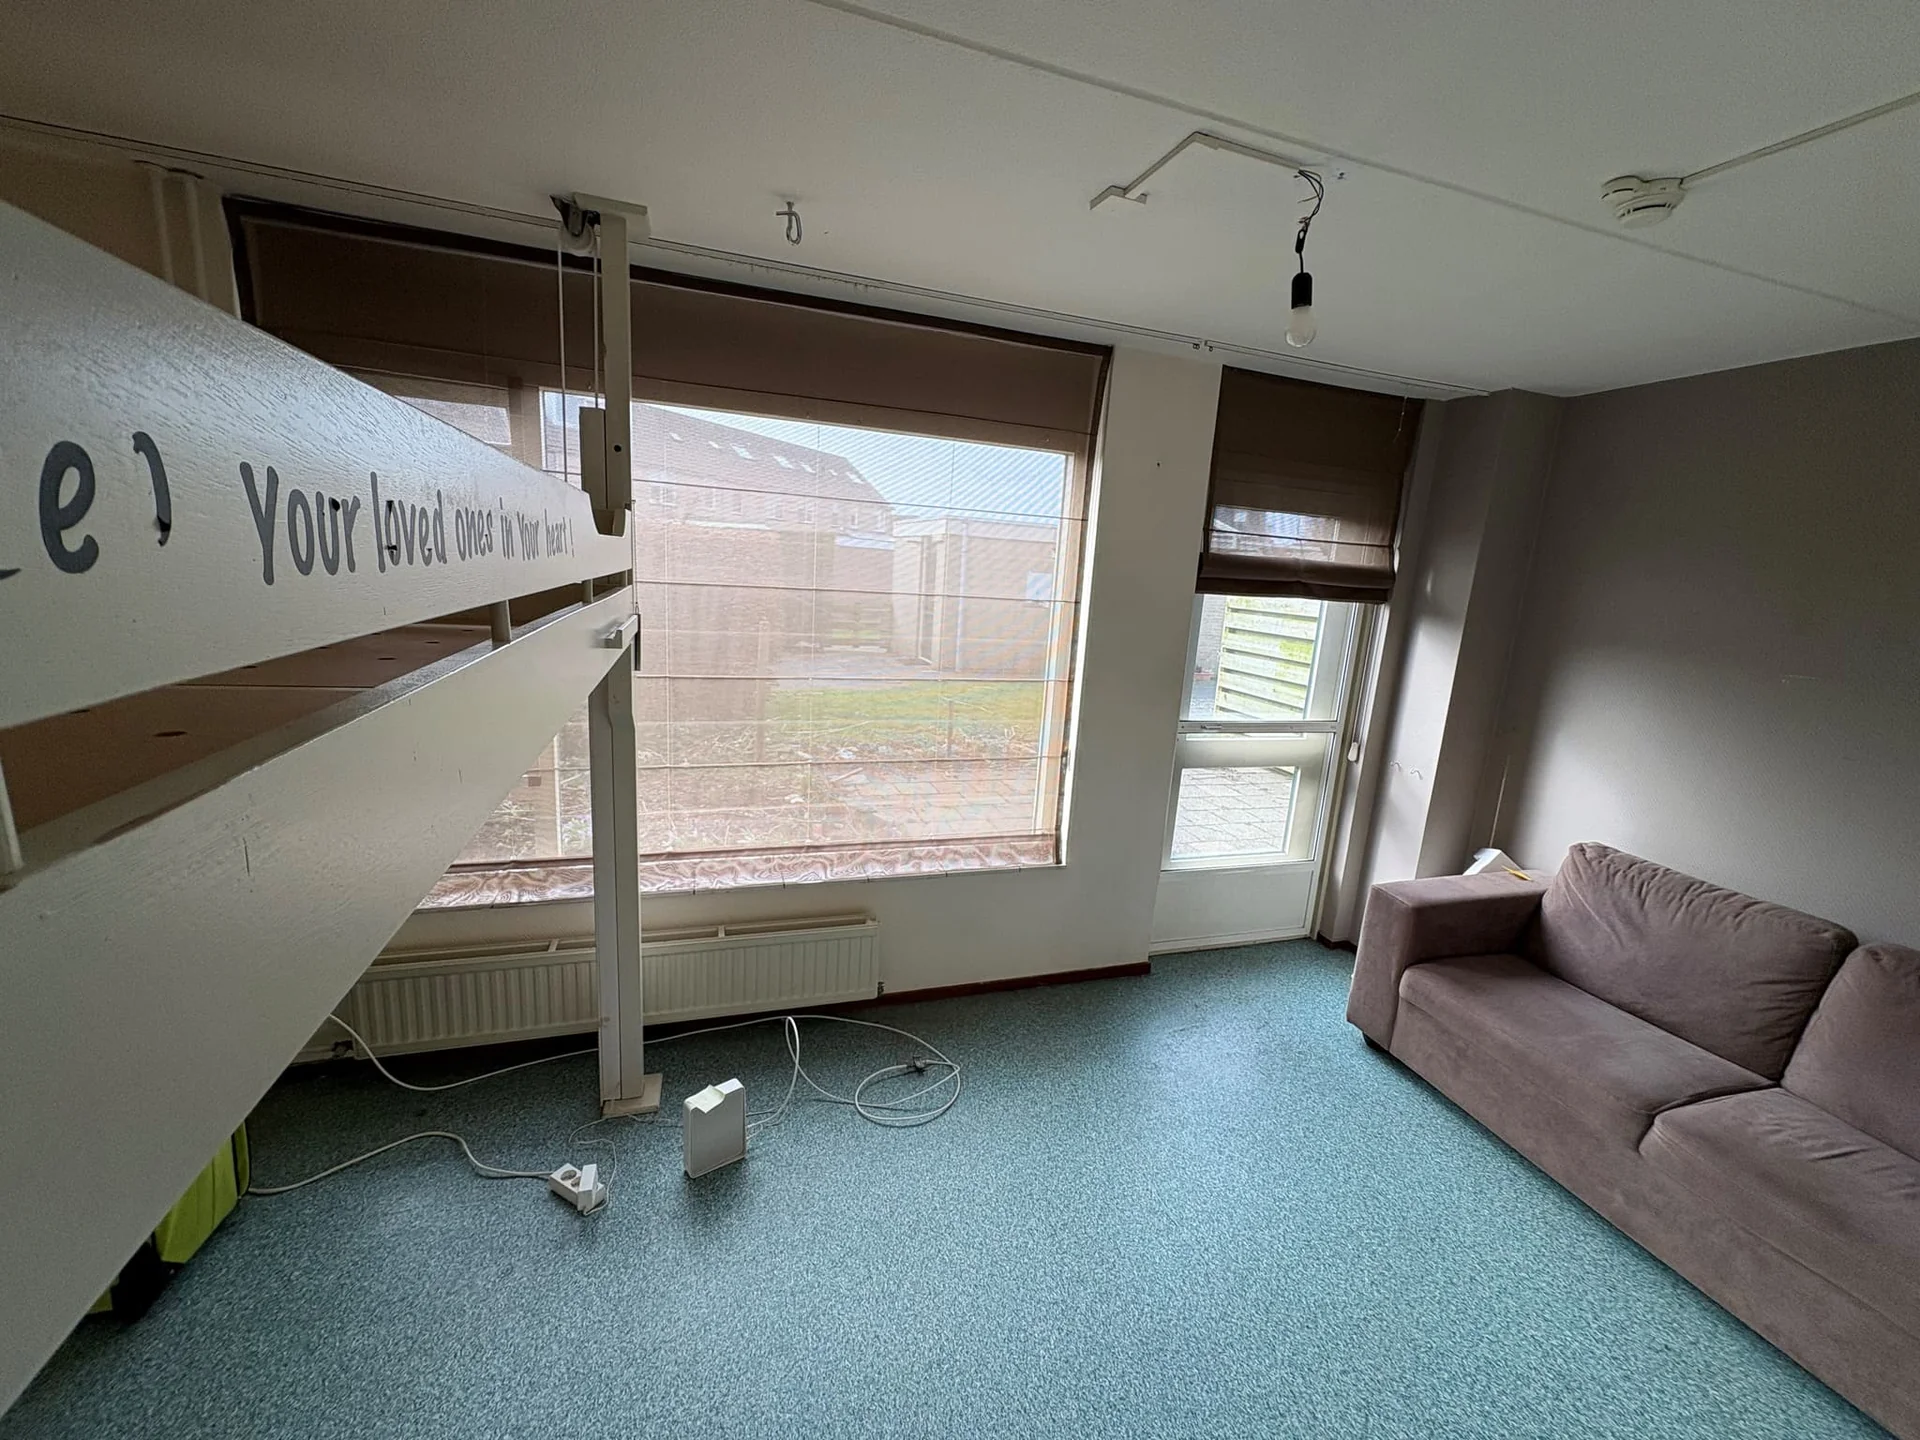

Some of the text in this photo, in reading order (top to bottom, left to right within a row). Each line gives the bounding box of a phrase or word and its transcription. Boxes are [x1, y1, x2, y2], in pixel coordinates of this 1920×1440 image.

[239, 461, 361, 586] Your
[370, 471, 447, 573] loved
[455, 506, 493, 562] ones
[499, 496, 514, 560] in
[516, 510, 540, 561] Your
